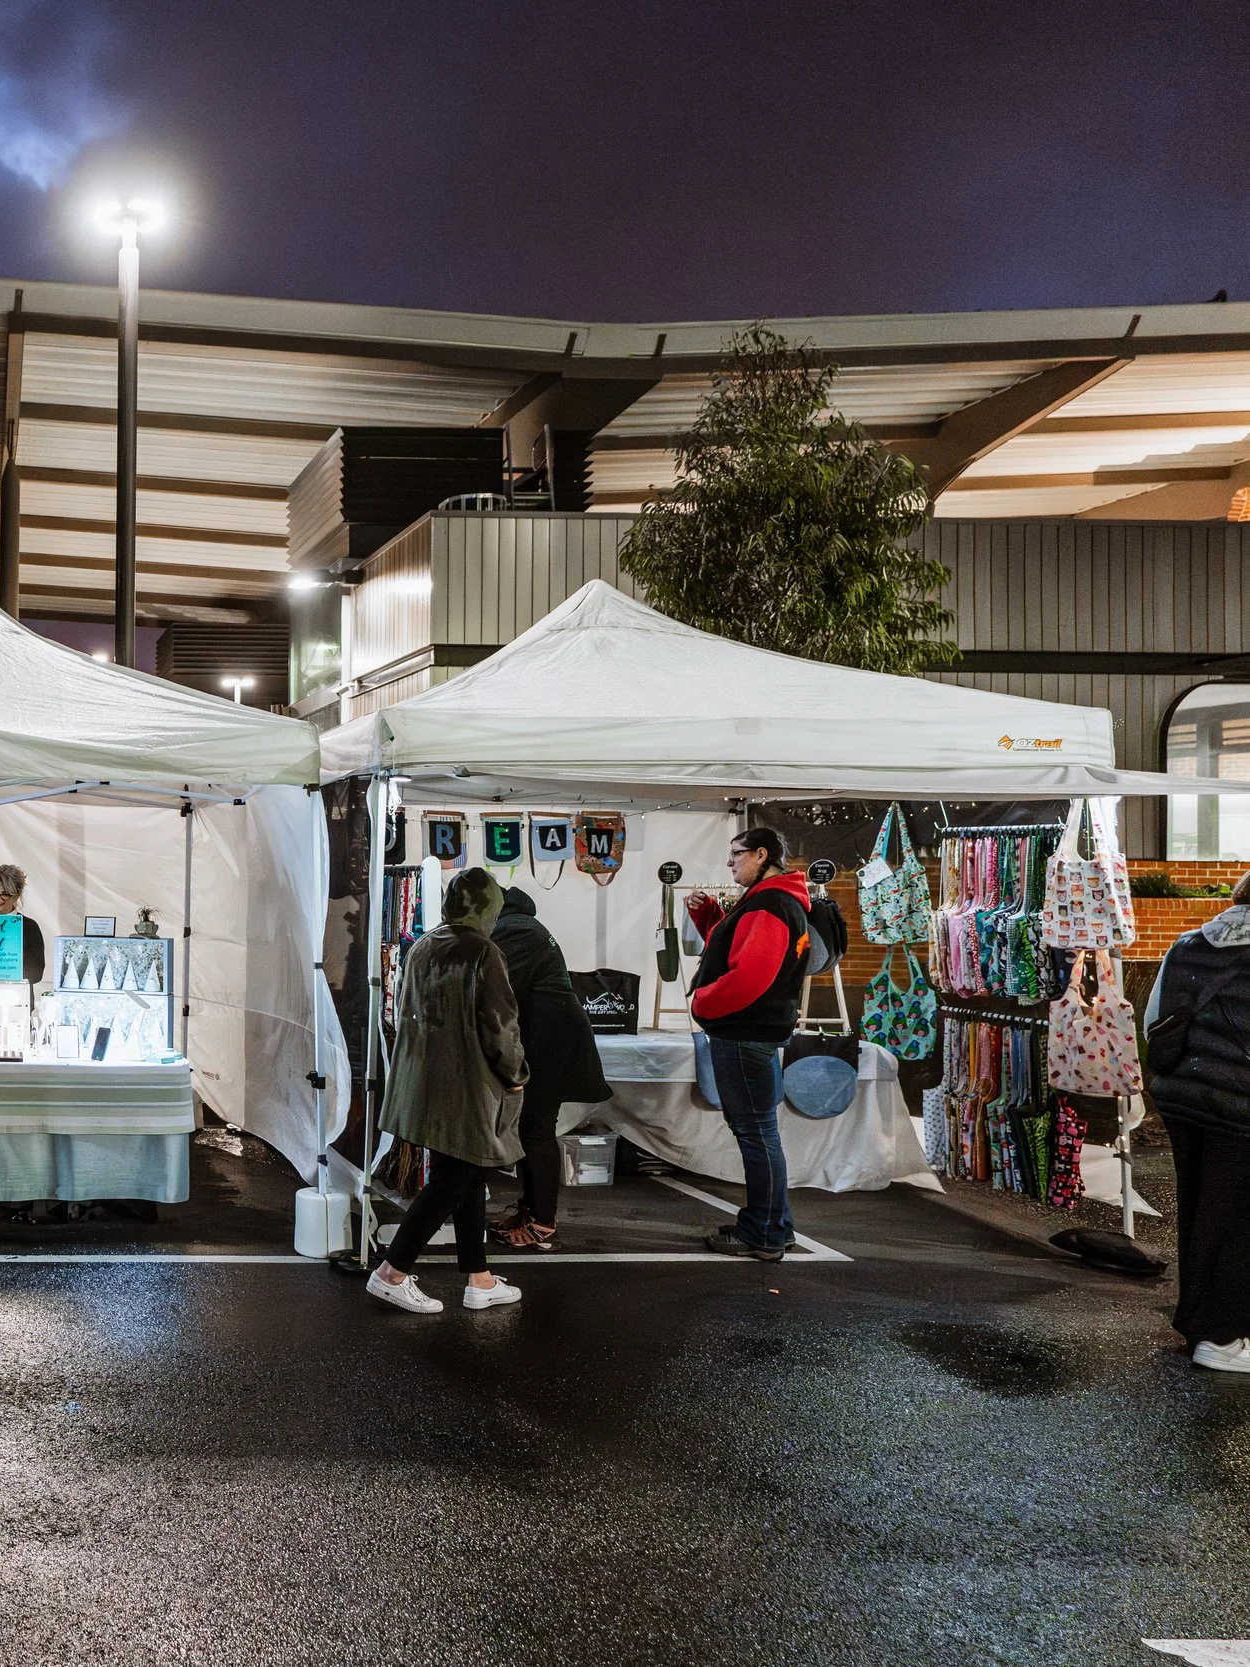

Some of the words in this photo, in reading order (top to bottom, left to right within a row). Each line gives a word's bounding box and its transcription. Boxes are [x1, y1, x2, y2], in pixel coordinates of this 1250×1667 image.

[436, 824, 455, 855] R
[494, 826, 512, 856] E
[545, 830, 562, 847] A
[591, 834, 608, 854] M
